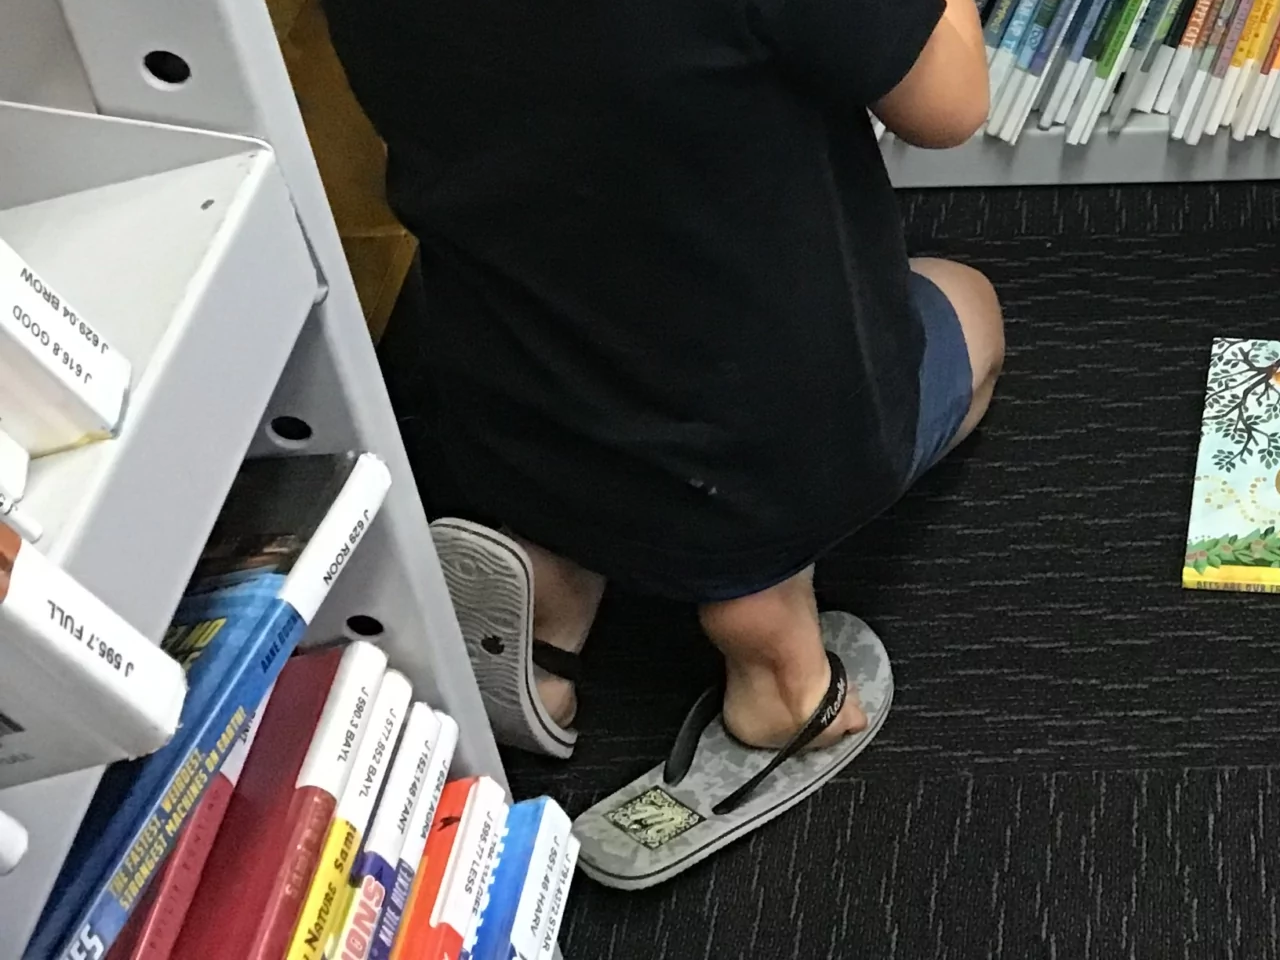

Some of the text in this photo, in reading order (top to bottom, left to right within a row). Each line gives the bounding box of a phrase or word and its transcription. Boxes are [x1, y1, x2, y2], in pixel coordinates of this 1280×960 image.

[7, 304, 93, 384] J 616.8 GOOD
[16, 267, 109, 354] J 629.04 BROW
[321, 508, 372, 585] J 629 ROON
[39, 598, 89, 641] FULL
[84, 632, 126, 670] 595.7
[120, 661, 136, 678] J
[334, 685, 370, 764] J 590.3 BAYL
[356, 707, 398, 799] J 577.852 BAYL
[422, 739, 433, 751] J
[440, 759, 450, 770] J
[115, 833, 172, 911] STRONGEST
[160, 769, 211, 836] MACHINES
[201, 749, 222, 772] ON
[213, 704, 250, 753] EARTH!
[394, 796, 415, 834] FANT
[106, 870, 129, 896] THE
[462, 810, 495, 894] J 595.77 LESS
[526, 835, 561, 936] J 551.46 HARV
[539, 853, 572, 951] J 791.4372 STAR
